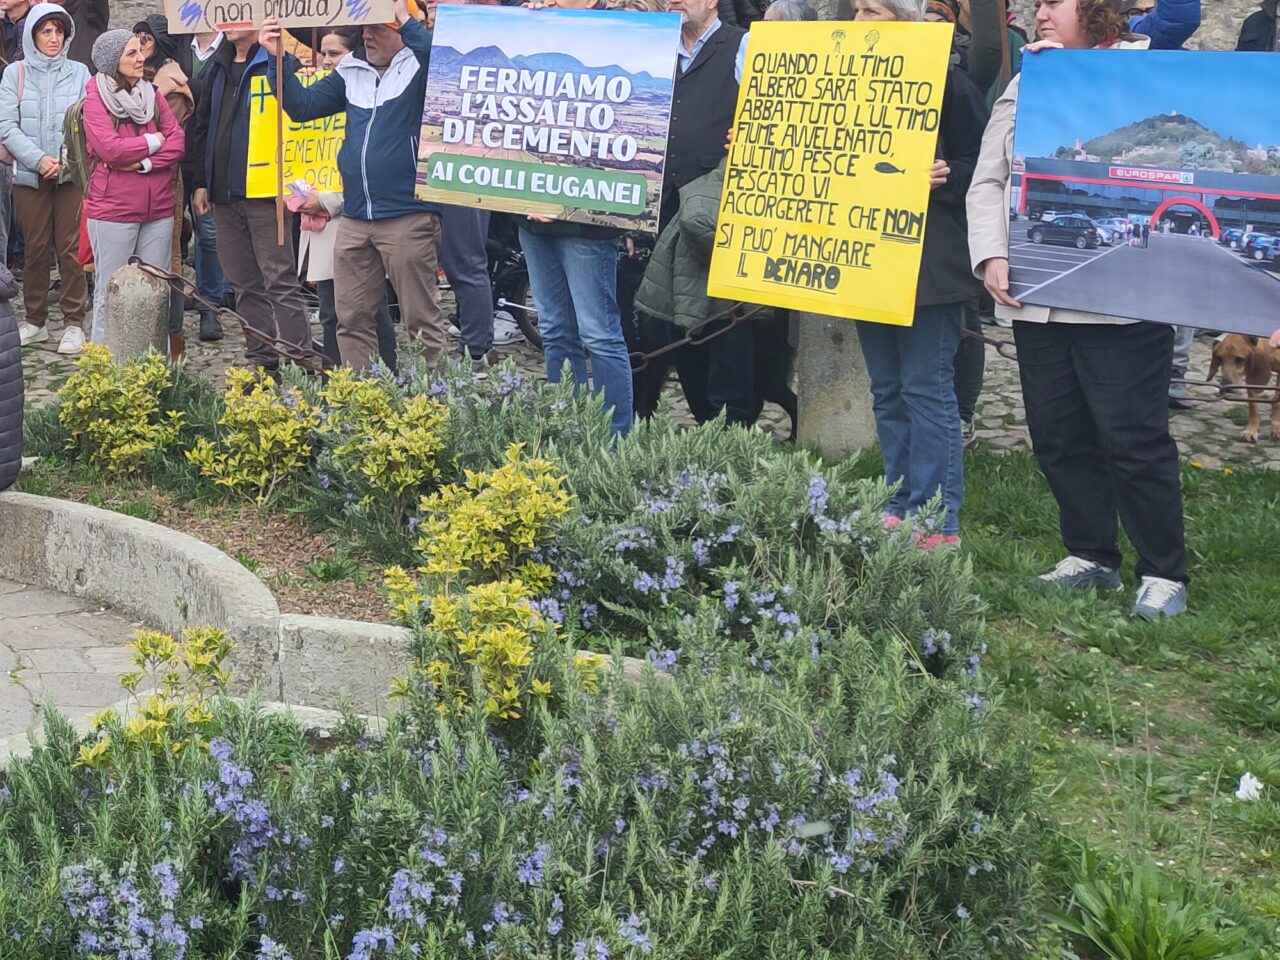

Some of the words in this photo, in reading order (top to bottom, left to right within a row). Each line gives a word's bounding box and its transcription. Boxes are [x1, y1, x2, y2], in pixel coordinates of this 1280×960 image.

[752, 53, 818, 76] QUANDO
[824, 54, 904, 78] L'ULTIMO
[459, 65, 632, 103] FERMIAMO
[747, 76, 807, 98] ALBERO
[865, 80, 933, 106] STATO
[461, 92, 615, 131] L'ASSALTO
[739, 99, 848, 128] ABBATTUTO,
[853, 104, 939, 132] L'ULTIMO
[442, 118, 475, 145] DI
[482, 123, 638, 162] CEMENTO
[734, 122, 778, 144] FIUME
[730, 144, 795, 171] L'ULTIMO
[801, 150, 860, 177] PESCE
[1116, 169, 1180, 181] EUROSPAR
[431, 160, 454, 181] AI
[458, 163, 525, 190] COLLI
[531, 172, 641, 205] EUGANEI
[727, 168, 805, 197] PESCATO
[814, 176, 831, 199] VI
[722, 191, 839, 226] ACCORGERETE
[848, 205, 881, 231] CHE
[883, 208, 924, 237] NON
[718, 223, 734, 246] SI
[782, 233, 876, 267] MANGIARE
[737, 252, 748, 275] IL
[764, 256, 841, 289] DENARO
